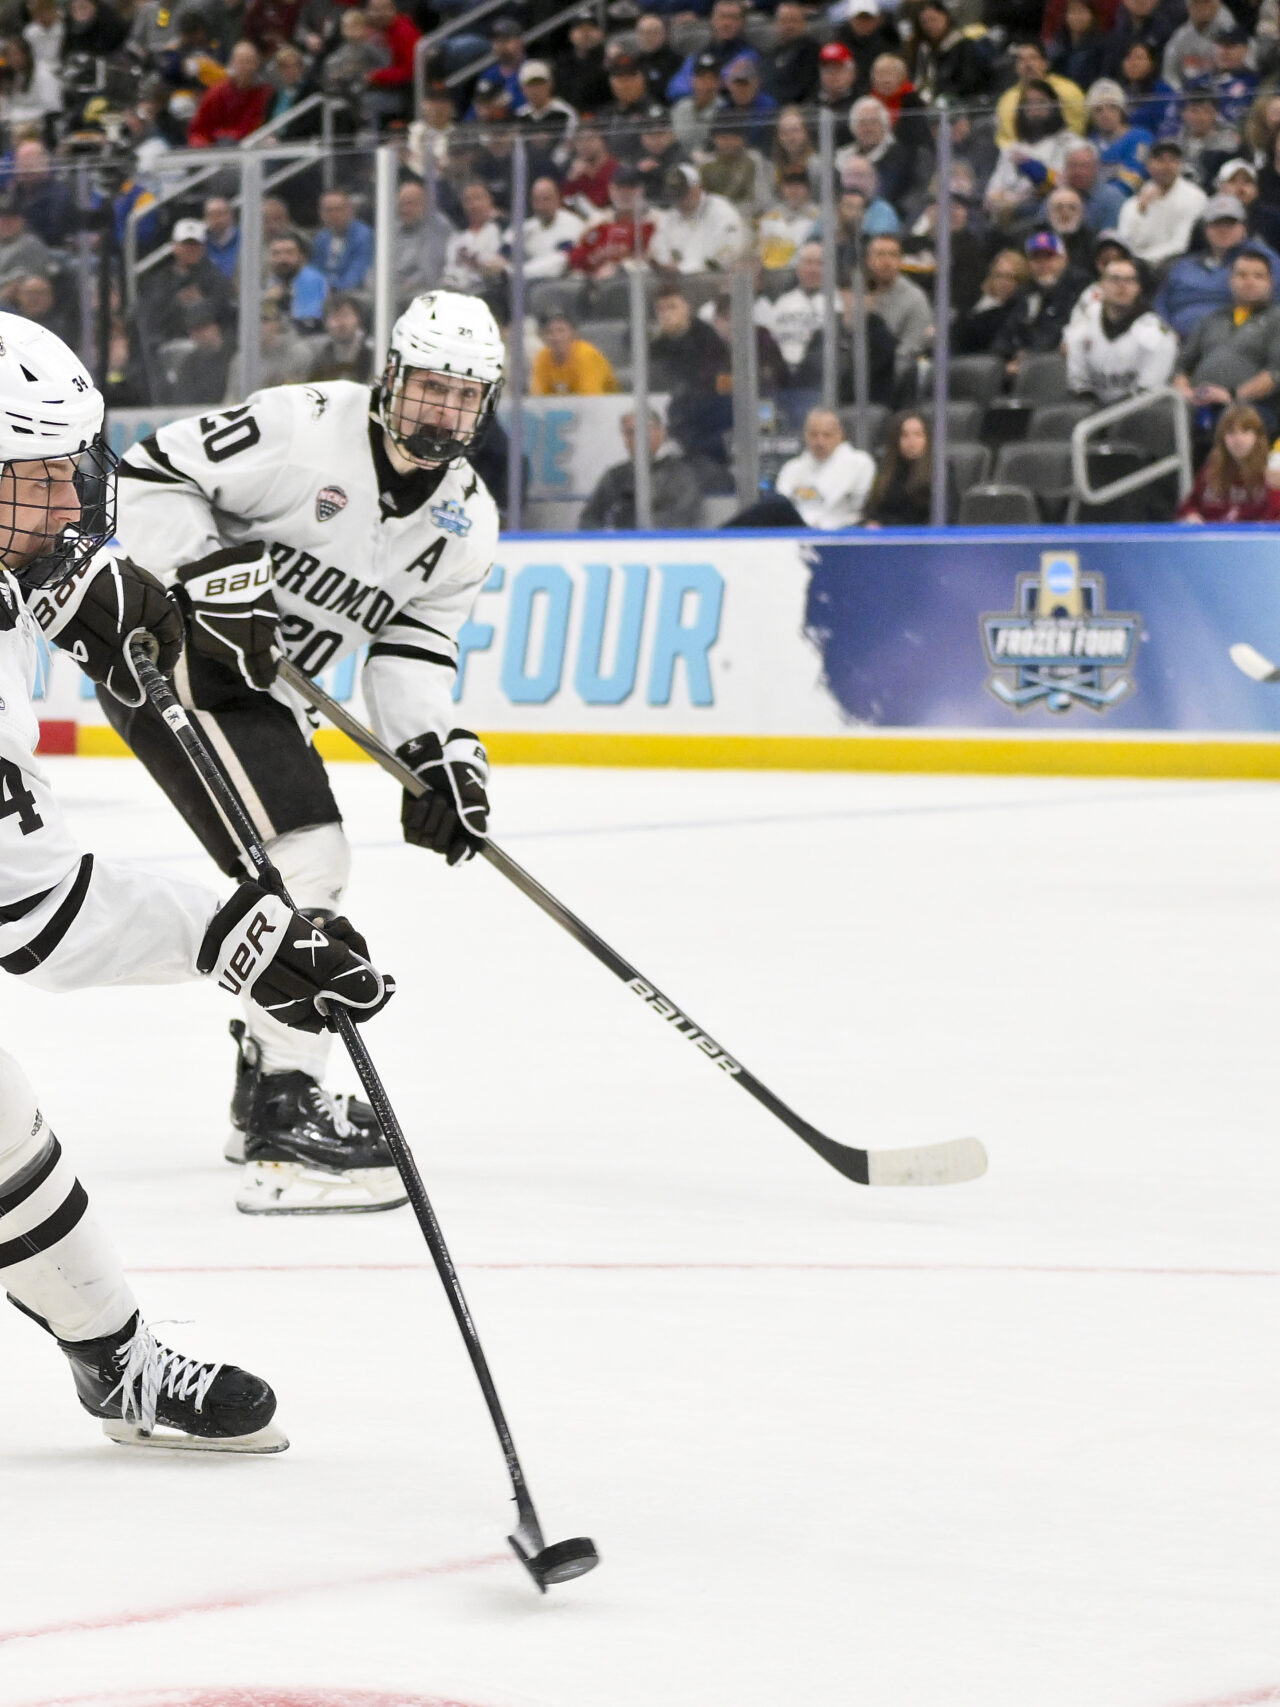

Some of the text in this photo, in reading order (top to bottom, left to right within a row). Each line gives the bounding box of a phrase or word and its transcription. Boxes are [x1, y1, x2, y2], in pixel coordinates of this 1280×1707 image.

[72, 375, 89, 392] 34
[405, 535, 448, 582] A
[279, 614, 344, 679] 20
[451, 563, 726, 707] FOUR
